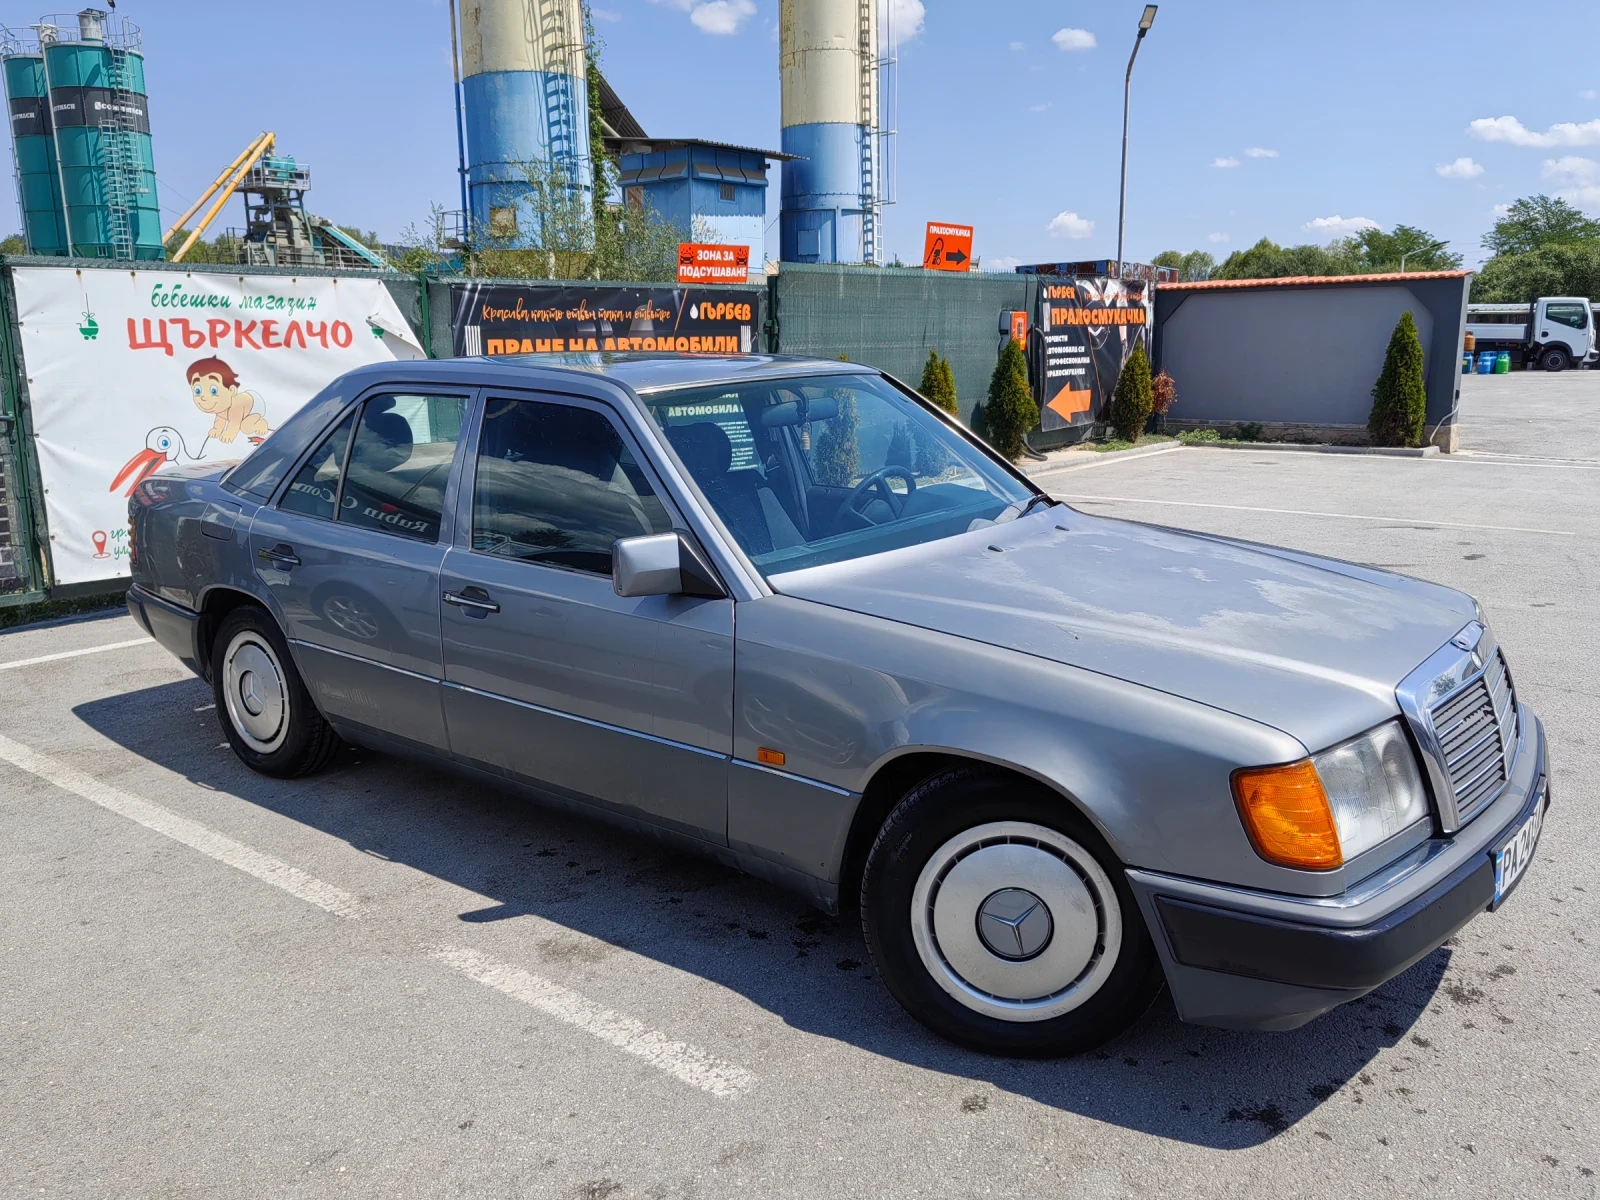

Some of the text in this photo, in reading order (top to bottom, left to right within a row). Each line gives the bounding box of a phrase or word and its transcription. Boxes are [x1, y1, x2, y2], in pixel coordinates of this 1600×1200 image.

[929, 225, 971, 238] ПРАХОСМУКАЧКА
[697, 249, 734, 262] ЗОНА ЗА
[679, 265, 747, 279] ПОДСУШАВАНЕ
[151, 283, 317, 317] бебешки магазин
[1048, 285, 1075, 299] ГЪРБЕВ
[483, 297, 671, 322] Красива както отвън така и отвътре
[700, 301, 752, 321] ГЪРБЕВ
[1050, 307, 1146, 326] ПРАХОСМУКАЧКА
[126, 317, 353, 357] ЩЪРКЕЛЧО
[487, 335, 738, 355] ПРАНЕ НА АВТОМОБИЛИ
[668, 404, 739, 417] АВТОМОБИЛА
